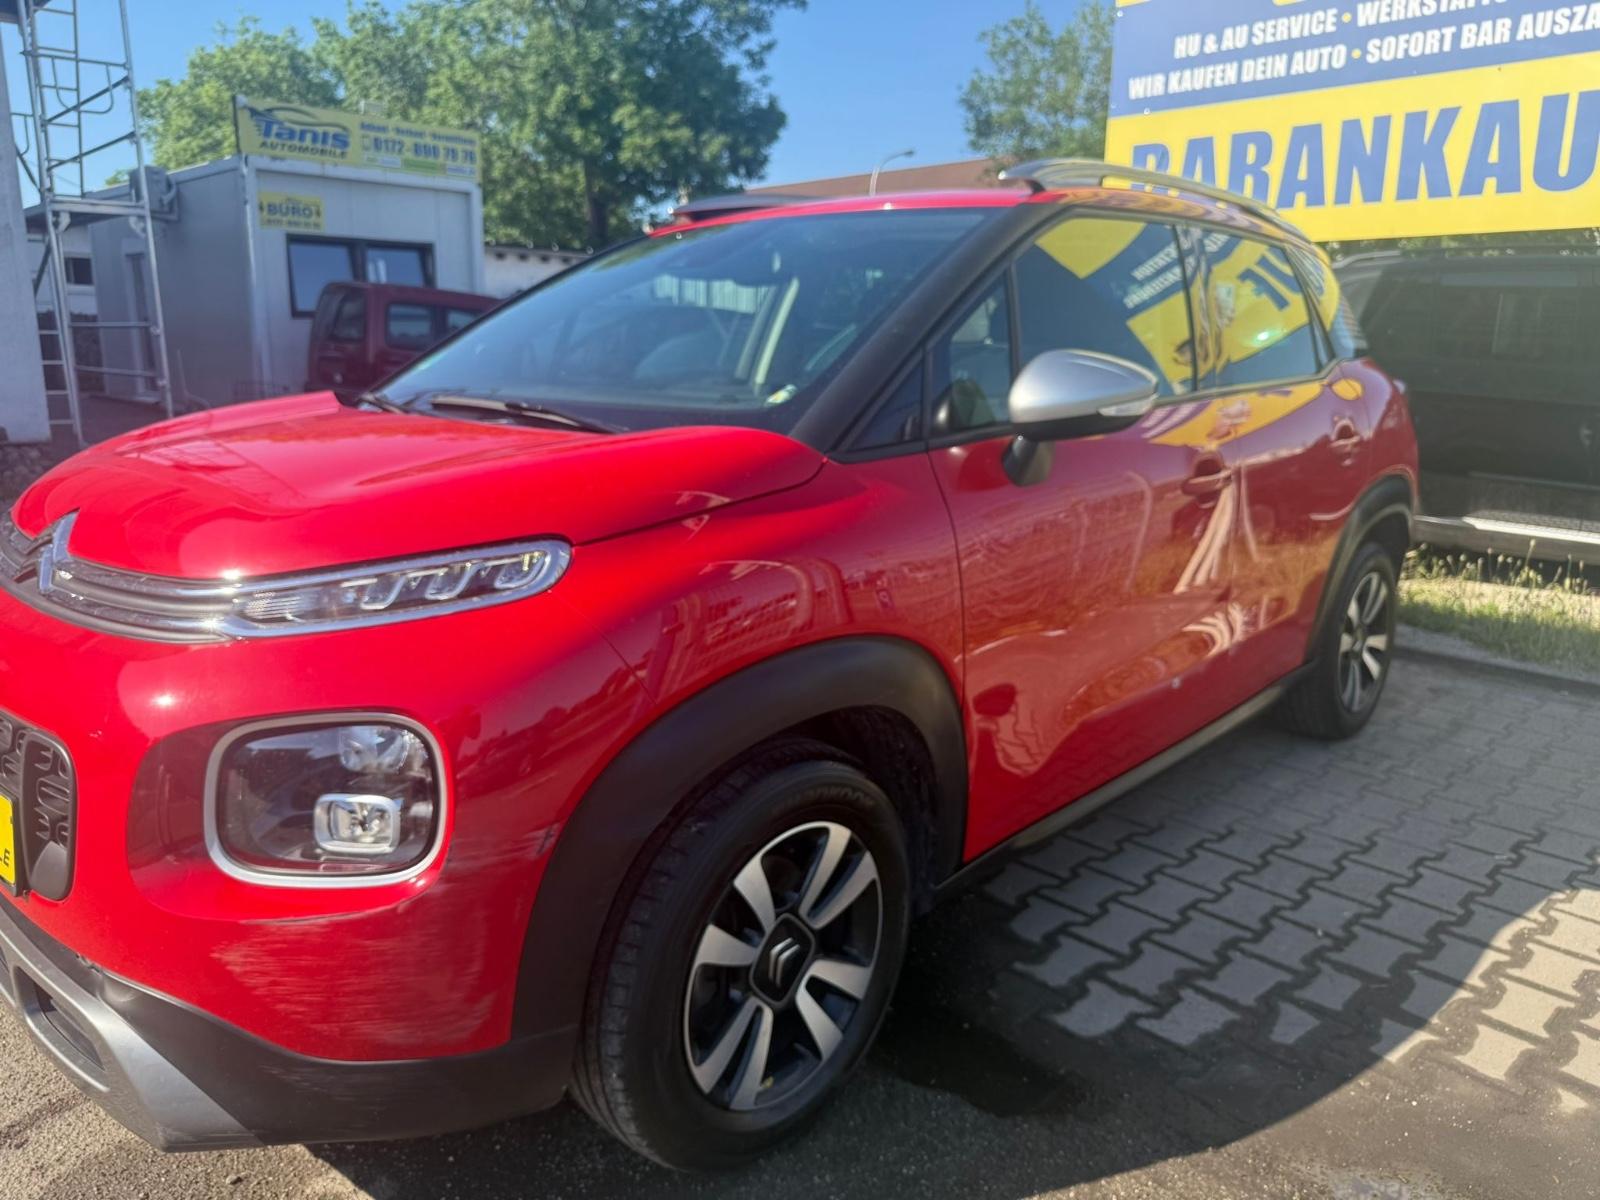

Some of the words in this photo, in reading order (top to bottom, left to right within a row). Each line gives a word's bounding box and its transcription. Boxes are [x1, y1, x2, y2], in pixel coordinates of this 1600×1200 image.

[1128, 73, 1166, 100] WIR
[1167, 61, 1238, 94] KAUFEN
[1241, 53, 1288, 83] DEIN
[1290, 44, 1347, 75] AUTO
[1366, 26, 1457, 64] SOFORT
[1460, 17, 1512, 49] BAR
[1174, 33, 1201, 59] HU
[1203, 34, 1218, 53] &
[1220, 24, 1249, 51] AU
[1251, 8, 1338, 46] SERVICE
[260, 140, 348, 159] AUTOMOBILE
